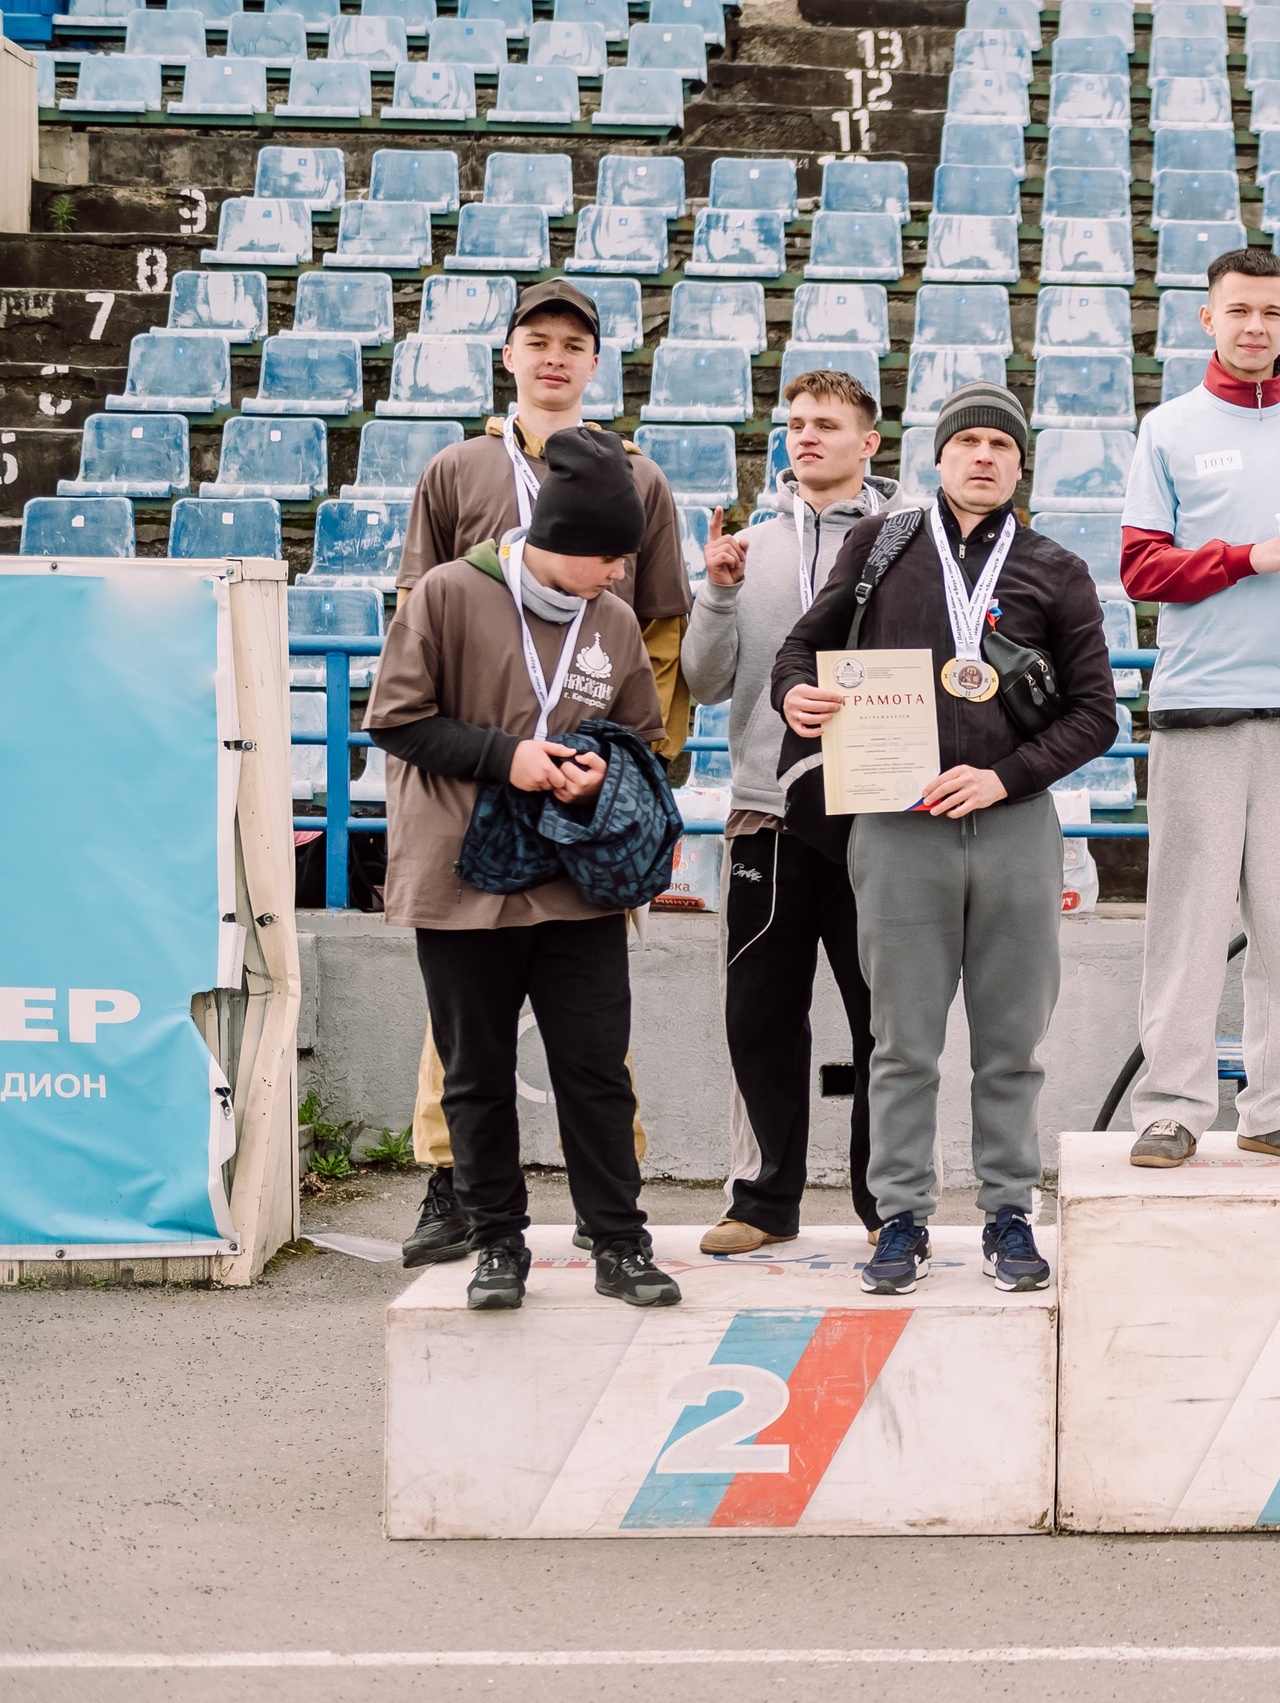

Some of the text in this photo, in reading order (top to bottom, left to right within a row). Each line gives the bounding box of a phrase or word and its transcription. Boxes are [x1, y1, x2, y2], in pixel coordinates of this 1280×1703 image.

[857, 30, 903, 69] 13
[845, 70, 893, 110] 12
[832, 109, 870, 151] 11
[136, 248, 168, 292] 8
[86, 293, 115, 340] 7
[1203, 456, 1234, 469] 1019
[842, 694, 925, 706] ГРАМОТА
[1, 1073, 106, 1102] ДИОН
[655, 1363, 790, 1474] 2
